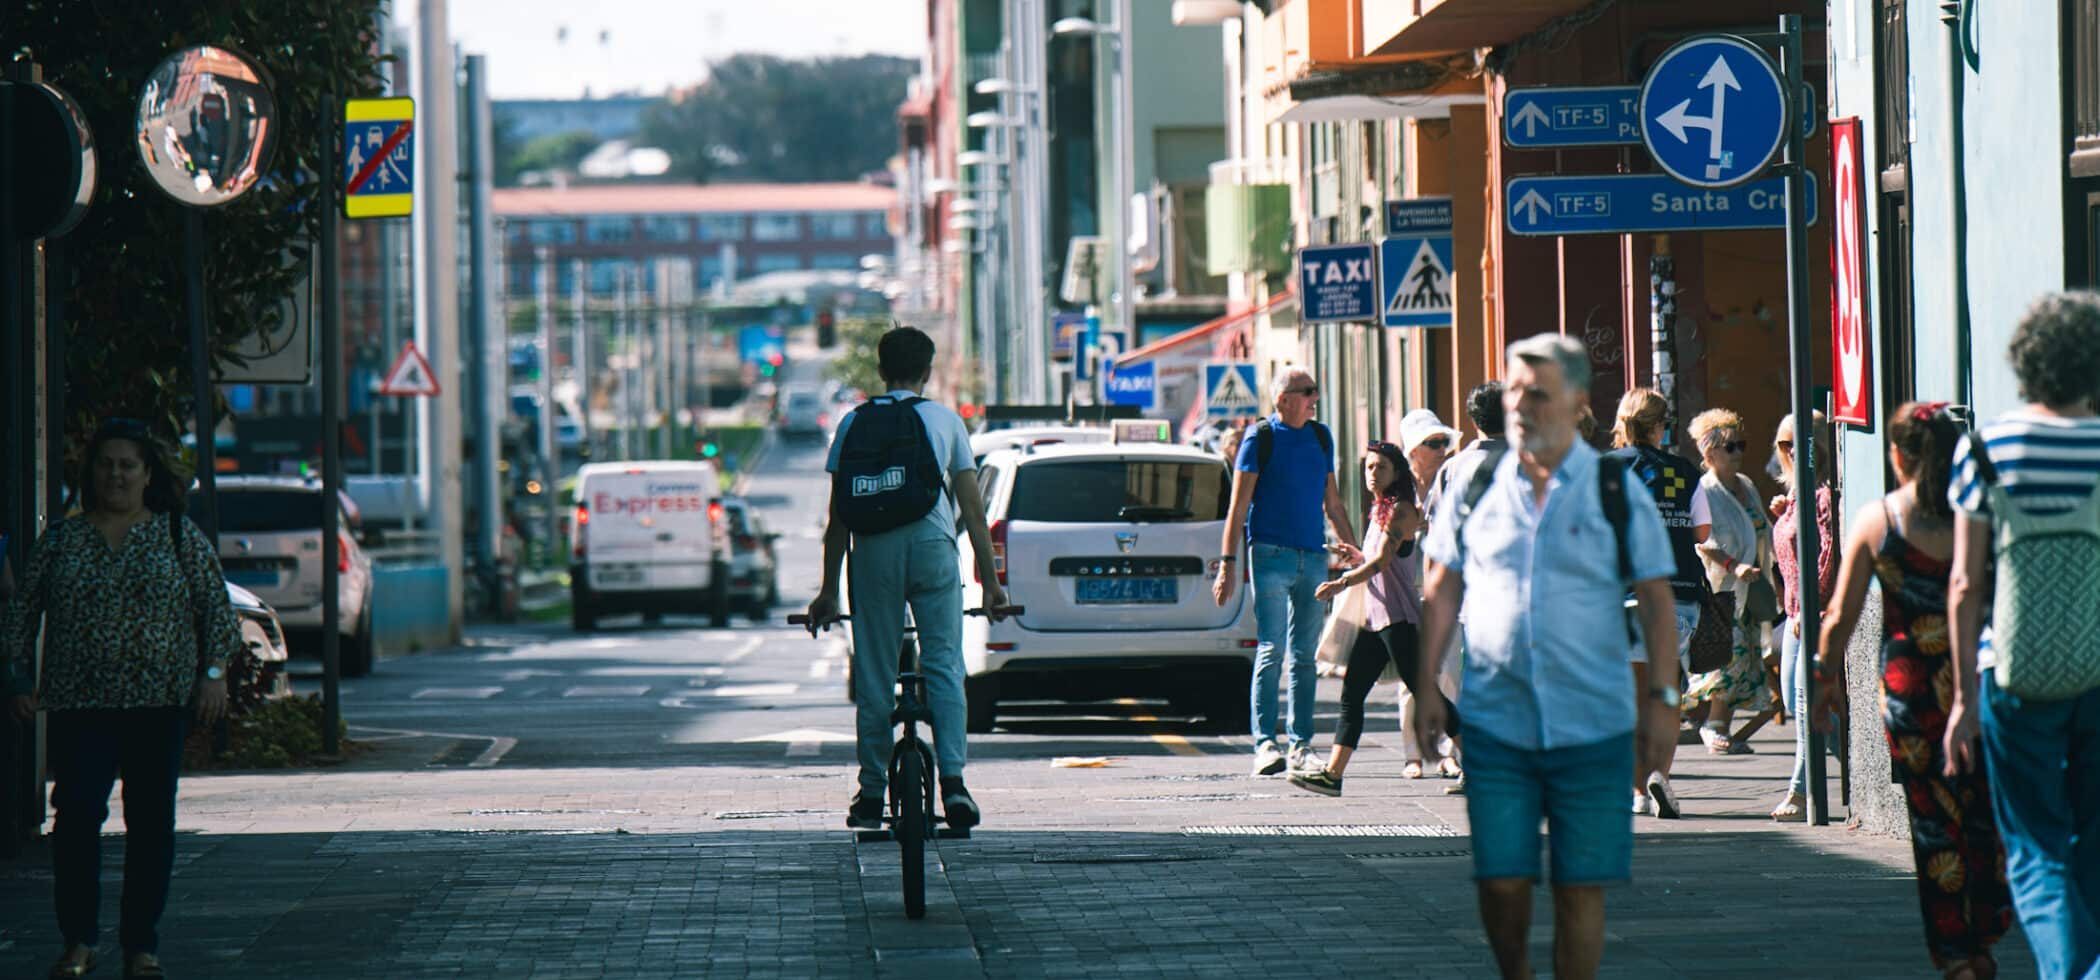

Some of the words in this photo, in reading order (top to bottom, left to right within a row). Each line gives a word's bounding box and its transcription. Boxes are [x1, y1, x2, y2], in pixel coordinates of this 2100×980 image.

[1557, 108, 1605, 125] TF-5
[1558, 196, 1607, 213] TF-5
[1652, 192, 1729, 212] Santa
[1304, 259, 1371, 285] TAXI
[594, 493, 701, 516] Express
